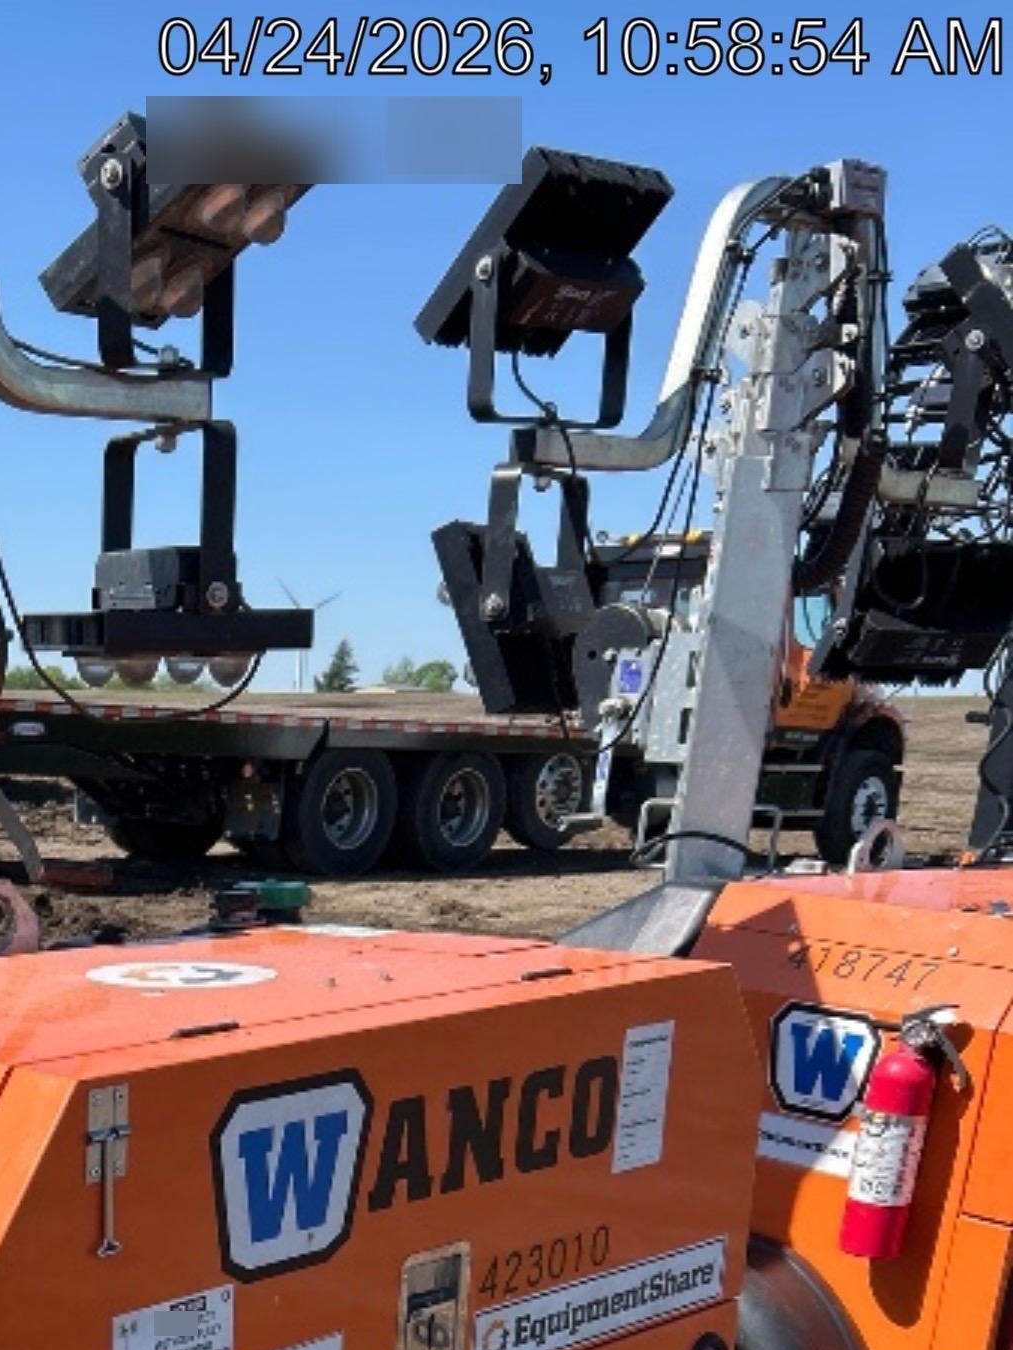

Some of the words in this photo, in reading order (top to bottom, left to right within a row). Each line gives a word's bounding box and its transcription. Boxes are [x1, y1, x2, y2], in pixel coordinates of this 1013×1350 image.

[790, 1022, 866, 1102] W
[238, 1056, 619, 1244] WANCO
[478, 1224, 610, 1299] 423010
[511, 1262, 715, 1347] EquipmentShare
